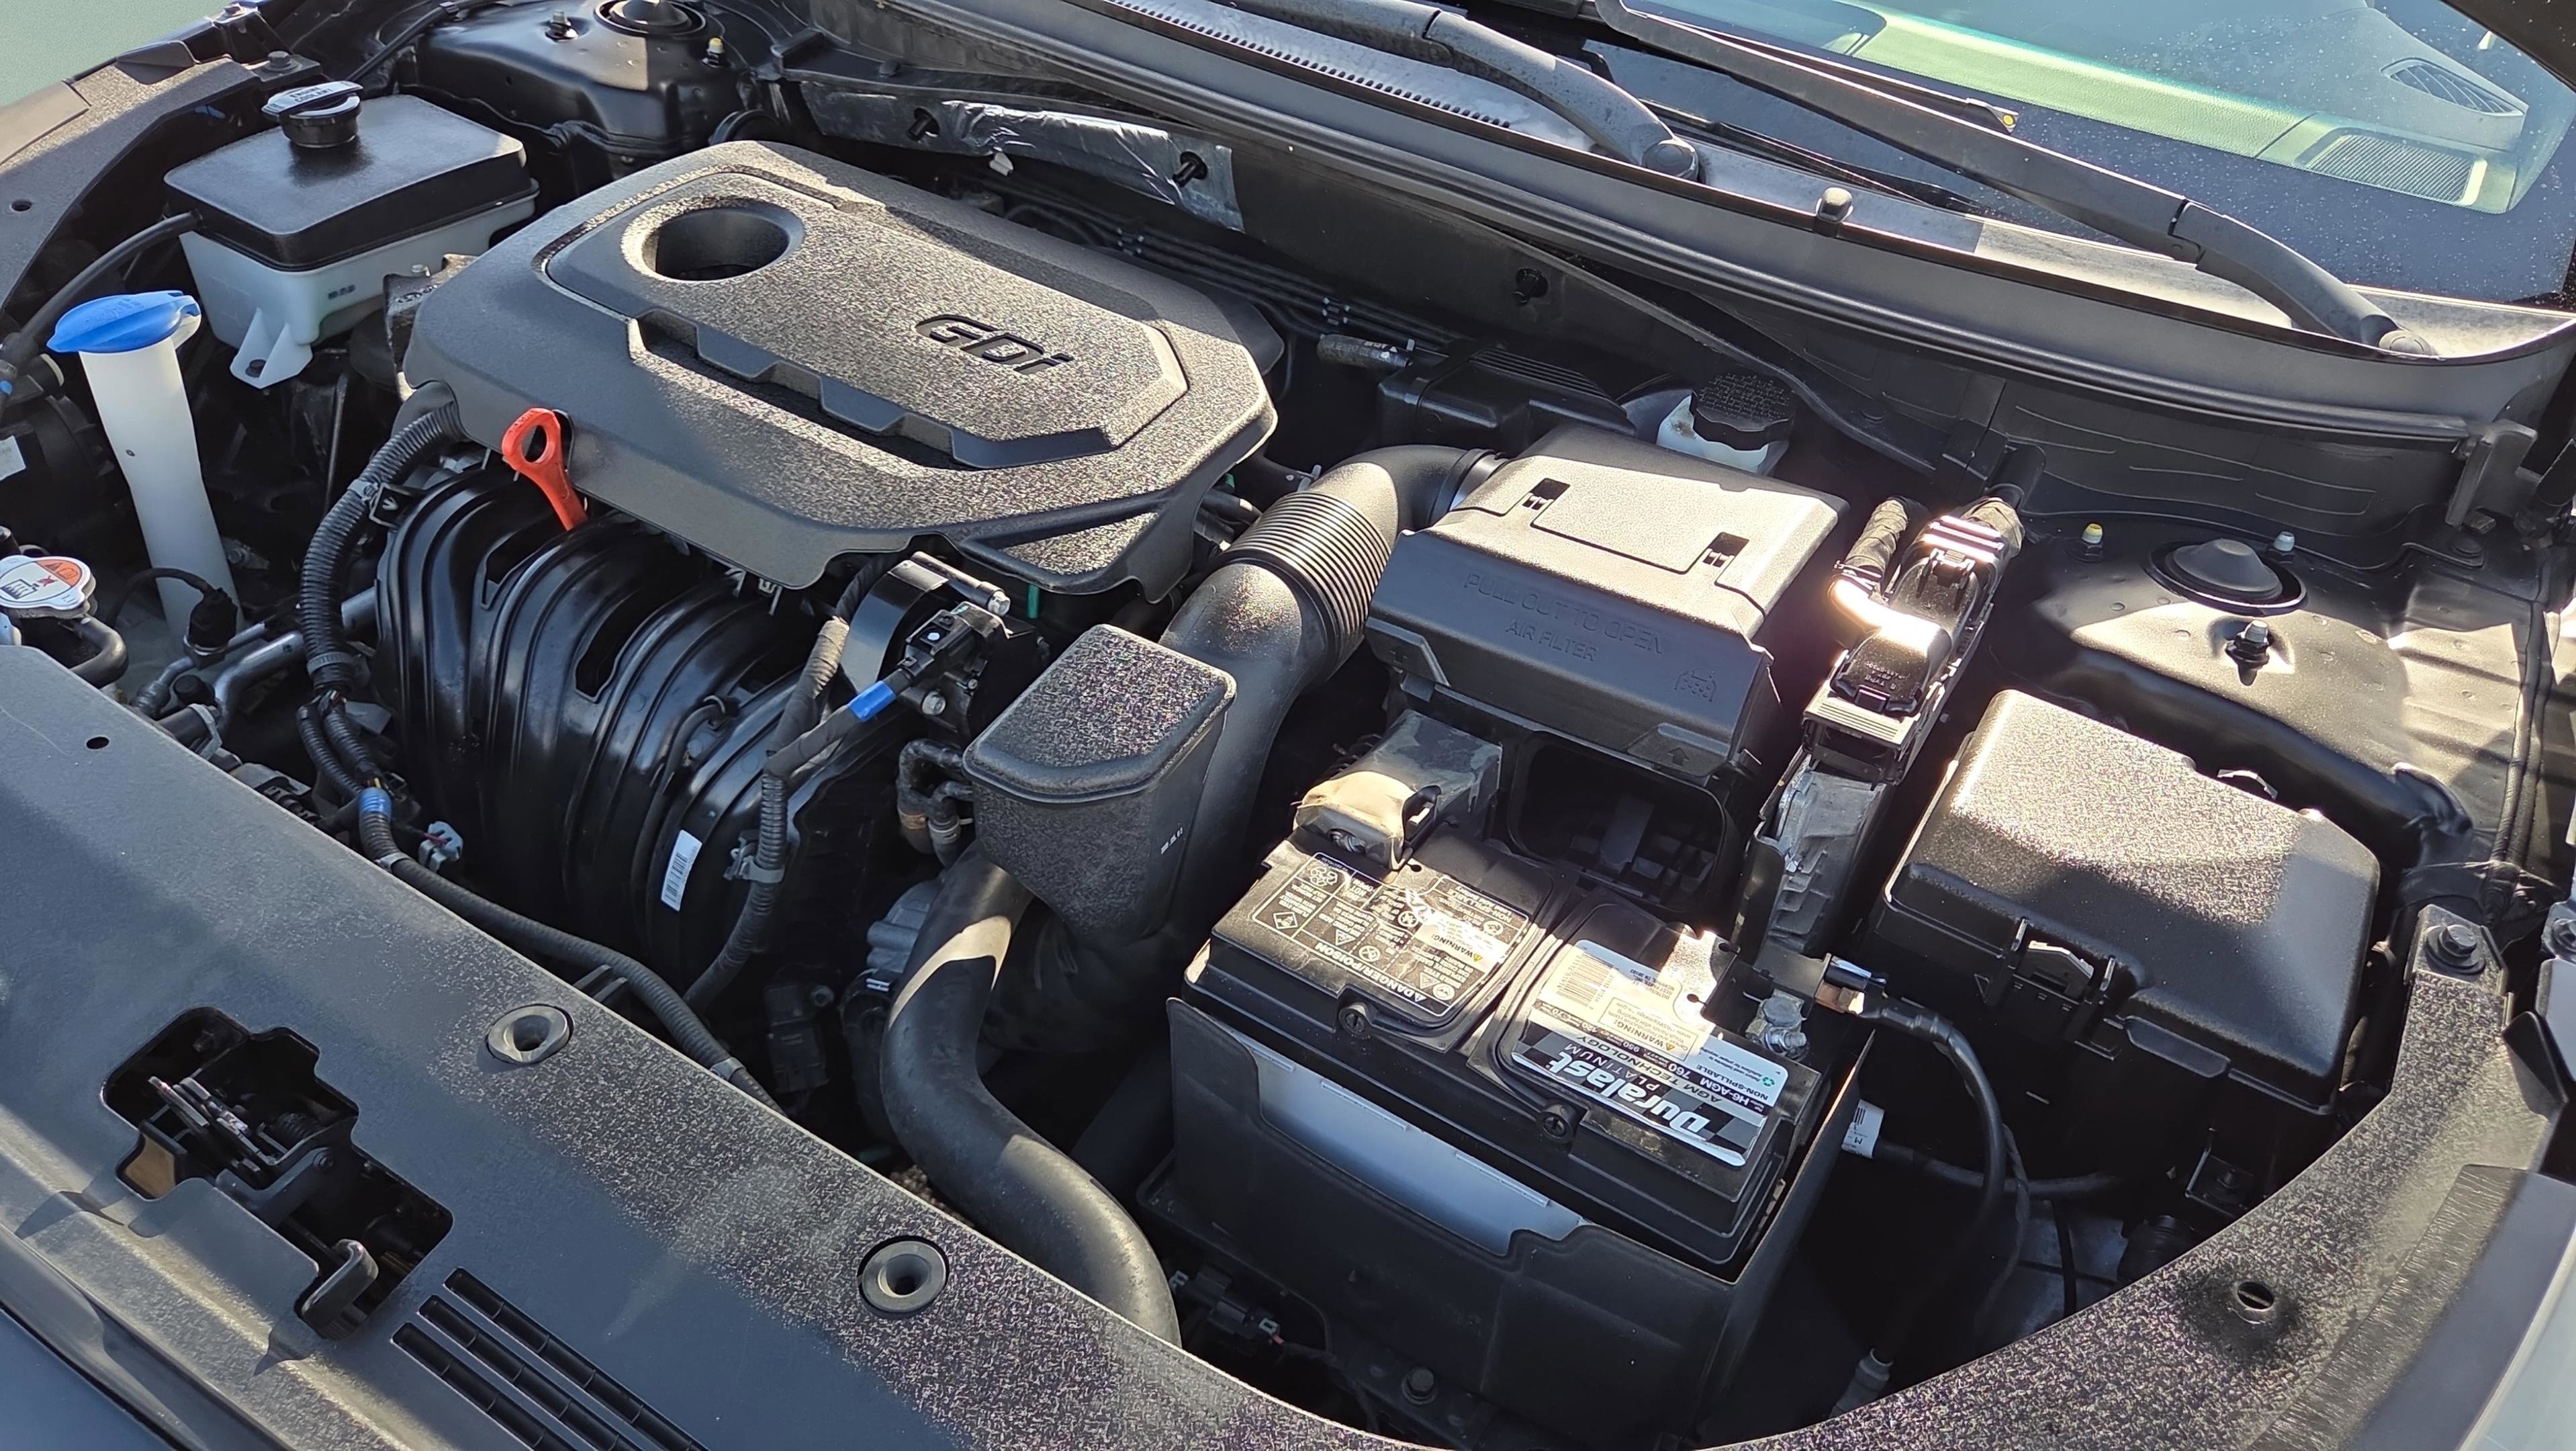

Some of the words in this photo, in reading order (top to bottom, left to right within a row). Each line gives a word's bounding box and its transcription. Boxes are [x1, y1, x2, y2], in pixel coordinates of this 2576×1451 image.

[294, 88, 334, 102] COOLANT
[915, 314, 1074, 375] GDi
[1463, 572, 1515, 605] PULL
[1521, 593, 1569, 620] OUT
[1573, 607, 1599, 632] TO
[1604, 620, 1665, 655] OPEN
[1505, 619, 1535, 642] AIR
[1538, 630, 1598, 662] FILTER
[1347, 885, 1367, 897] NOT
[1446, 889, 1513, 922] NON-SPILLABLE
[1461, 914, 1483, 926] READ
[1430, 933, 1475, 957] WARNING:
[1313, 941, 1416, 998] DANGER/POISON
[1580, 1021, 1597, 1032] 120
[1612, 1018, 1663, 1047] WARNING:
[1575, 1035, 1677, 1086] TECHNOLOGY
[1621, 1040, 1640, 1052] 950
[1563, 1043, 1660, 1091] PLATINUM
[1666, 1061, 1690, 1078] 760
[1548, 1050, 1710, 1141] Duralast
[1683, 1084, 1722, 1101] AGM
[1695, 1064, 1768, 1100] NON-SPILLABLE
[1698, 1076, 1749, 1105] H6-AGM
